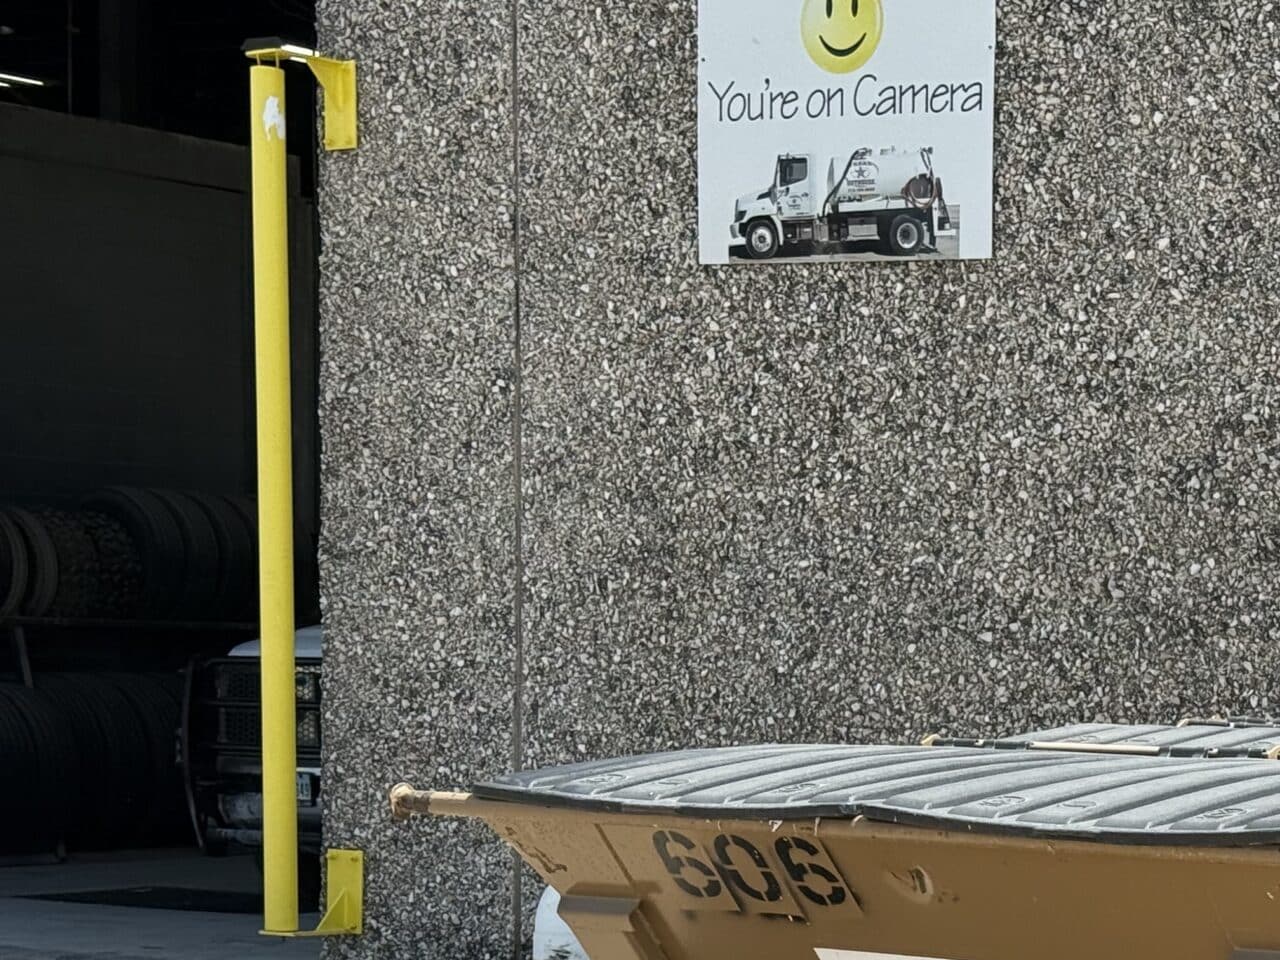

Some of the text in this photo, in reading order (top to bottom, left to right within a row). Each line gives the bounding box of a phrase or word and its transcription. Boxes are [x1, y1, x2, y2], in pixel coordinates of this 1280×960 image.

[708, 74, 982, 121] You're on Camera
[652, 830, 847, 906] 606
